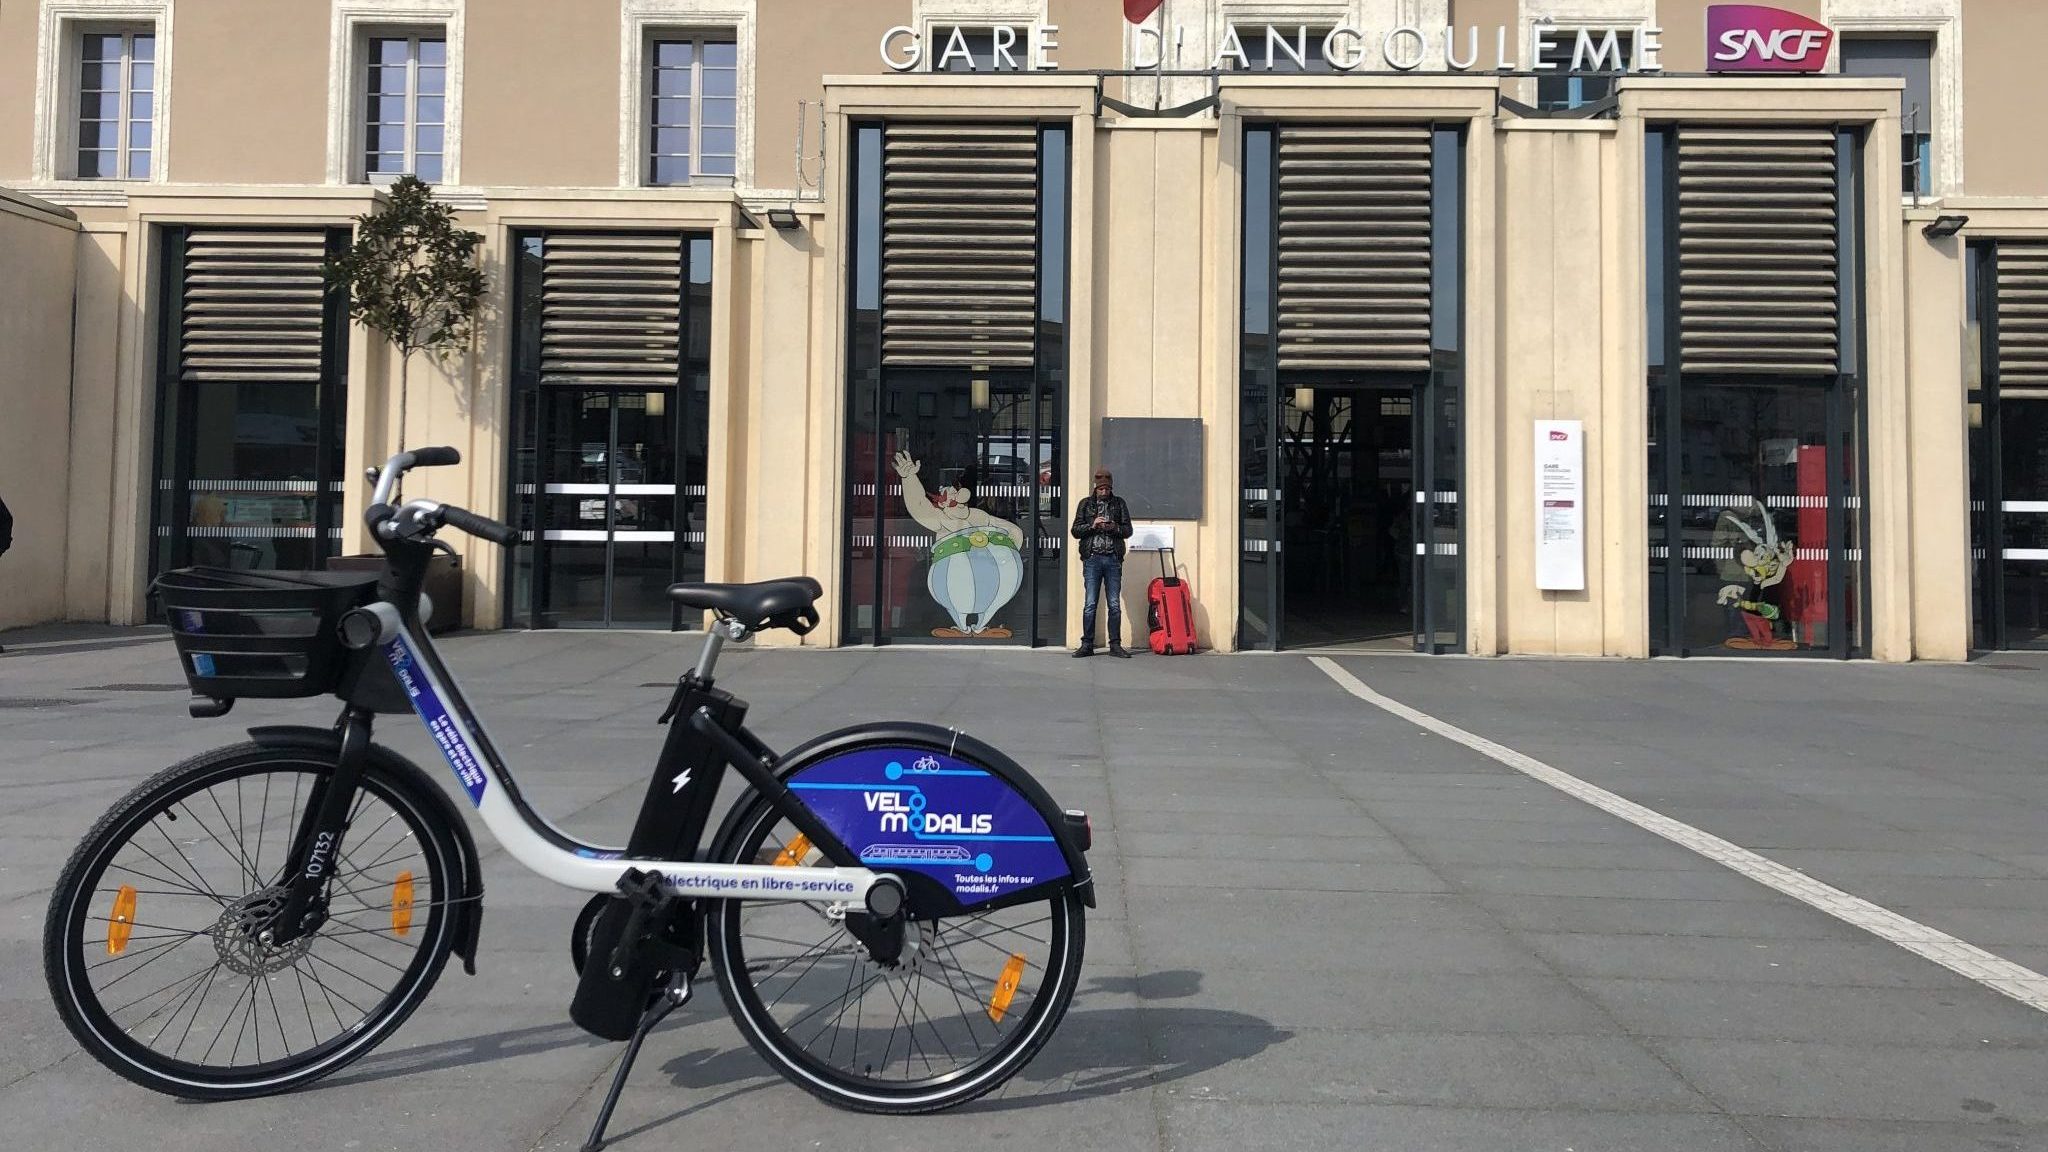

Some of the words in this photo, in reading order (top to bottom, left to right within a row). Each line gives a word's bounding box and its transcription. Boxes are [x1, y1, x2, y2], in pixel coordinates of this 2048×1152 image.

[879, 25, 1059, 71] GARE
[1714, 29, 1828, 61] SNCF
[864, 792, 927, 812] VELO
[305, 832, 335, 879] 107132
[741, 879, 758, 890] en
[762, 876, 854, 892] libre-service
[954, 873, 985, 884] Toutes
[985, 874, 997, 884] les
[998, 874, 1020, 884] infos
[1020, 876, 1034, 884] sur
[955, 884, 999, 893] modalis.fr
